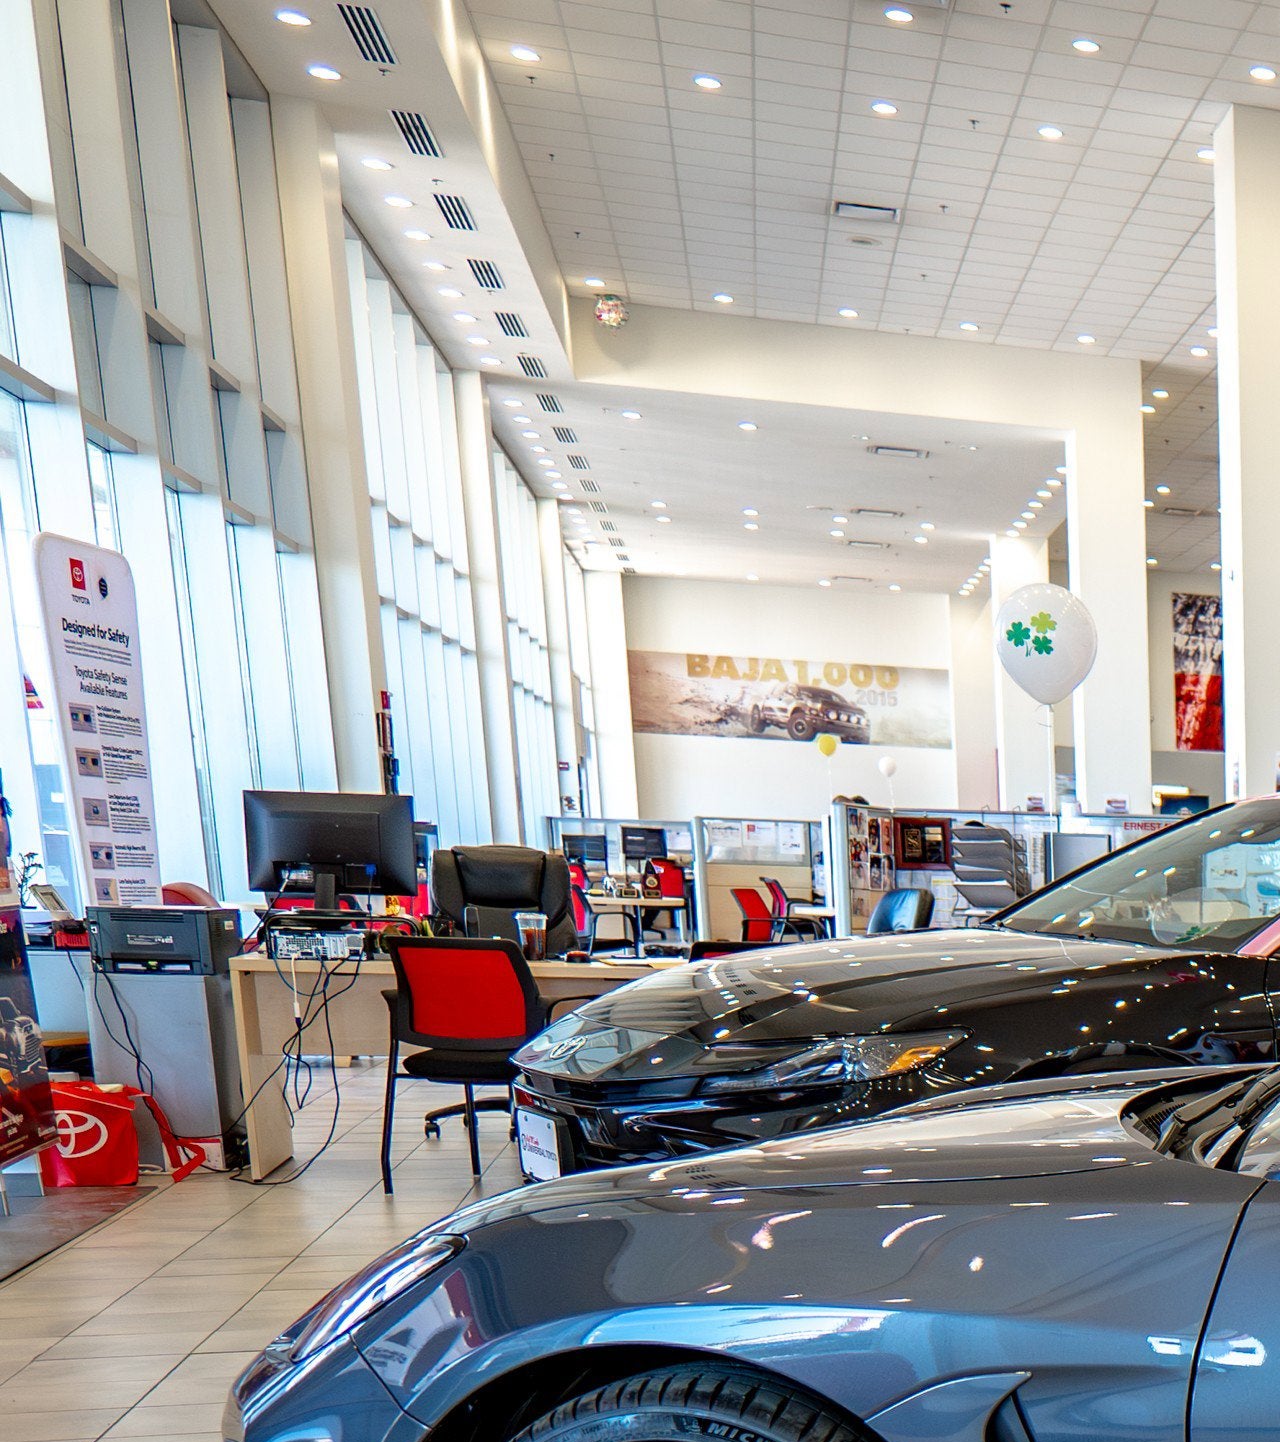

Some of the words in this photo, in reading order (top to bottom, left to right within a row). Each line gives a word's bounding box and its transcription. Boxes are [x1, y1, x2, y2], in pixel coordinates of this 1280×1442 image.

[71, 594, 91, 605] TOYOTA
[62, 618, 97, 639] Designed
[97, 624, 107, 639] for
[107, 628, 130, 648] Safety
[74, 665, 94, 680] Toyota
[94, 668, 111, 685] Safety
[685, 653, 789, 683] BAJA
[793, 660, 900, 691] 1,000
[80, 682, 105, 696] Available
[856, 689, 899, 707] 2015
[1124, 821, 1161, 831] ERNEST
